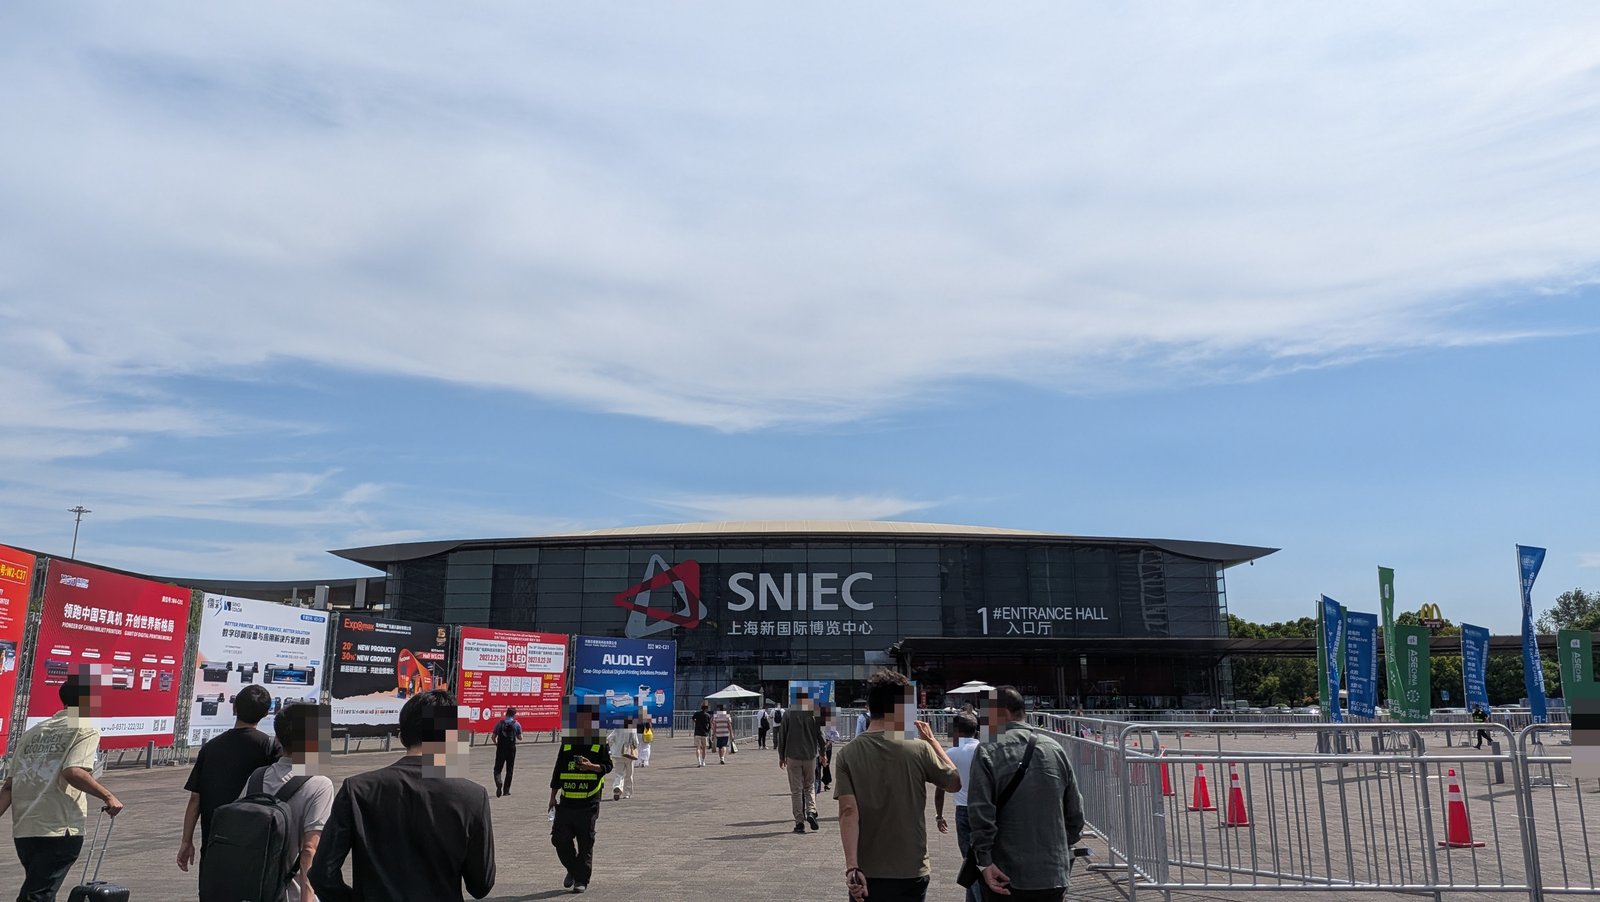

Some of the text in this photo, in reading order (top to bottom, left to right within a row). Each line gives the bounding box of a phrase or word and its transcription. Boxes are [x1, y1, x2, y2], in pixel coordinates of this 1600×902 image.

[728, 572, 874, 612] SNIEC
[64, 602, 175, 633] 领跑中国写真机 开创世界新格局
[992, 606, 1109, 620] #ENTRANCE HALL
[727, 620, 873, 636] 上海新国际博览中心
[977, 607, 988, 635] 1
[1006, 621, 1053, 636] 入口厅
[357, 644, 370, 652] NEW
[370, 645, 396, 653] PRODUCTS
[508, 645, 526, 654] SIGN
[512, 654, 526, 664] LED
[602, 654, 654, 666] AUDLEY
[24, 743, 66, 754] GOODNESS
